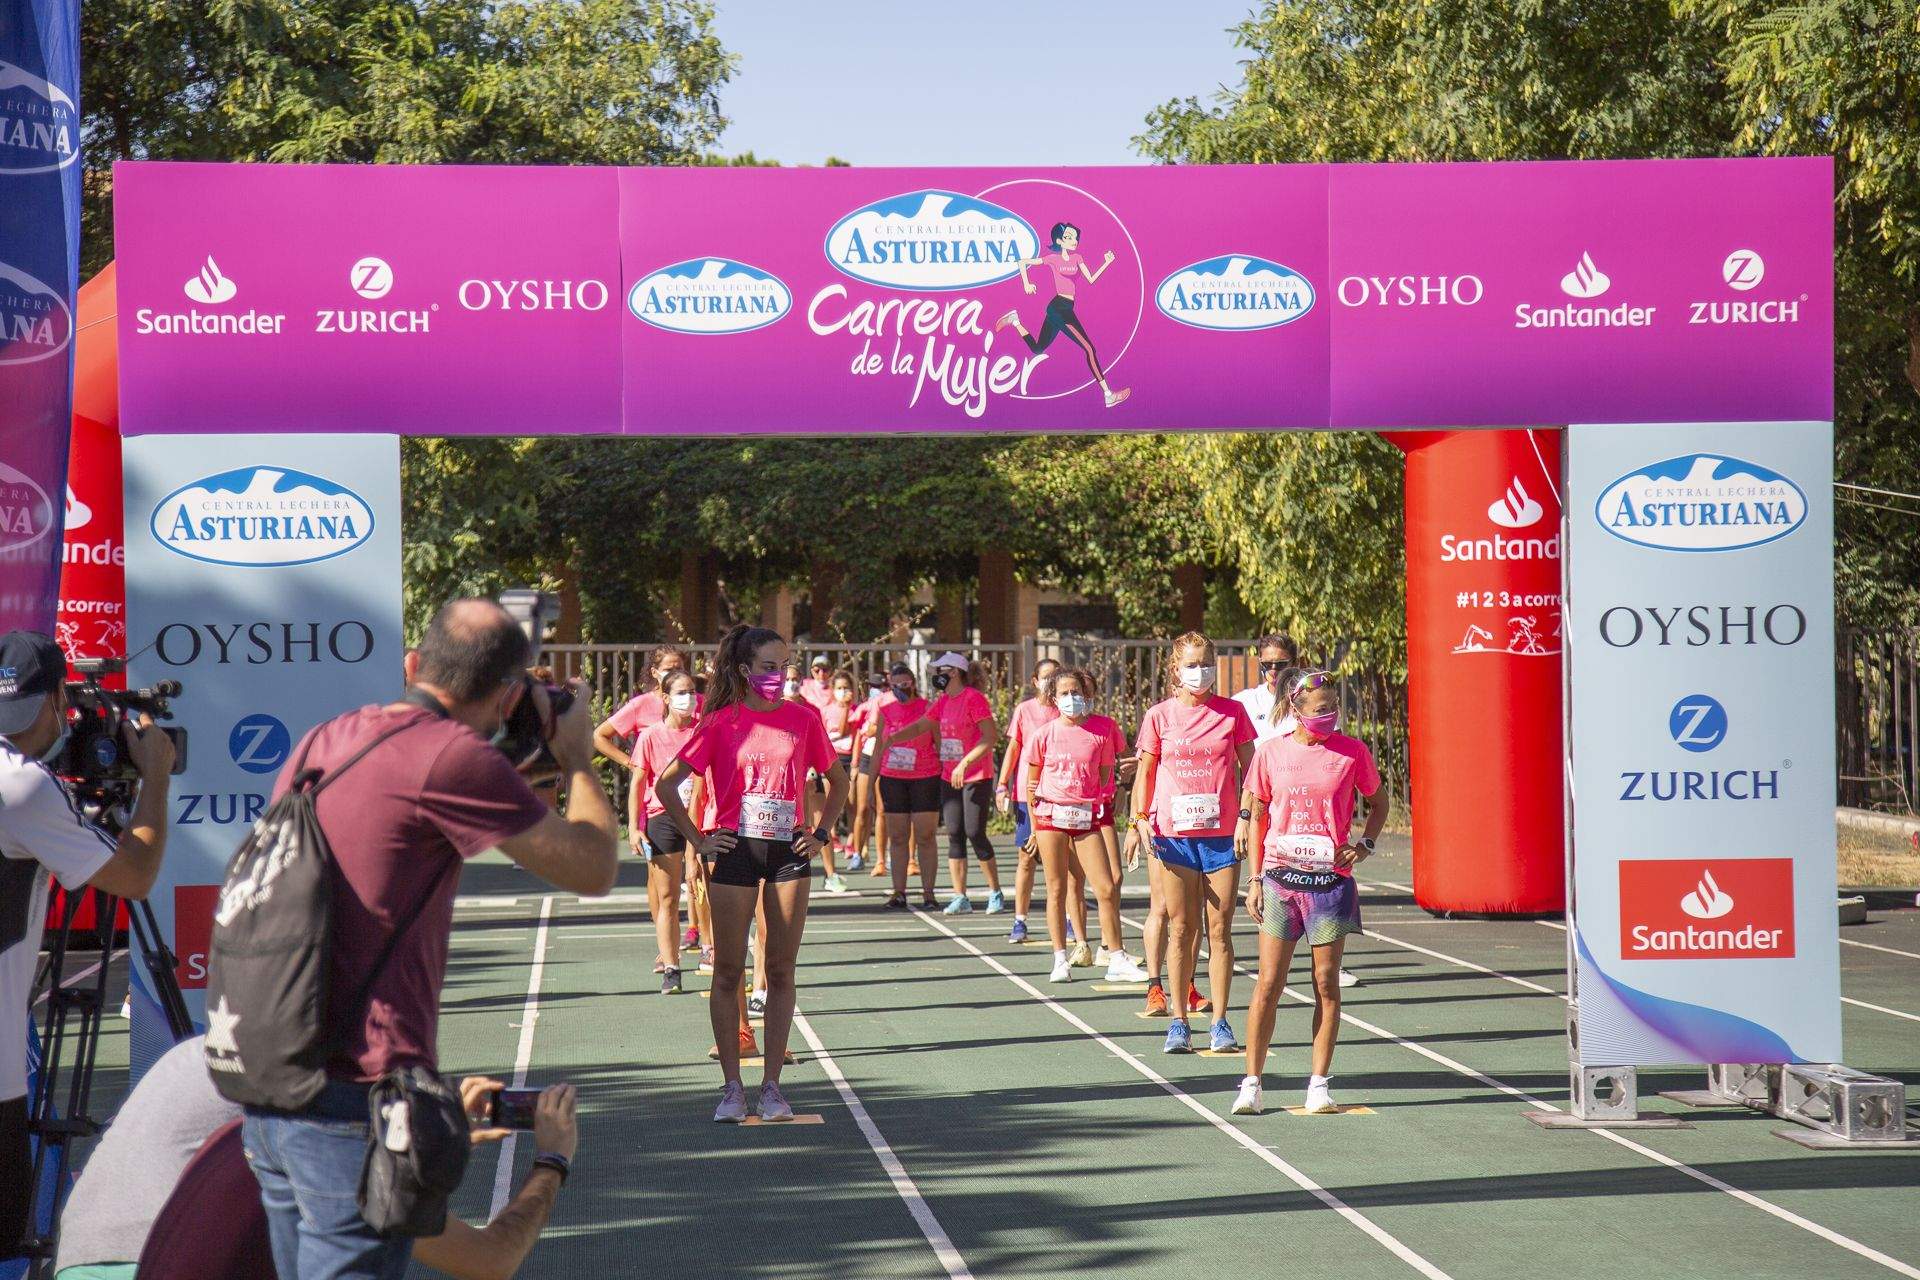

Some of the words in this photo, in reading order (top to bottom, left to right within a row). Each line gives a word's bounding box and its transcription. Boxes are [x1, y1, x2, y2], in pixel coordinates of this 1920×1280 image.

[874, 225, 942, 234] CENTRAL
[949, 224, 1016, 234] LECHERA
[842, 227, 1021, 264] ASTURIANA
[458, 279, 608, 311] OYSHO
[643, 286, 779, 313] ASTURIANA
[1169, 283, 1302, 310] ASTURIANA
[1337, 274, 1483, 308] OYSHO
[136, 309, 285, 334] Santander
[807, 283, 984, 337] Carrera
[1514, 302, 1656, 328] Santander
[851, 338, 884, 375] de
[891, 337, 914, 375] la
[909, 330, 1050, 418] Mujer
[202, 501, 272, 510] CENTRAL
[280, 500, 351, 510] LECHERA
[1644, 488, 1711, 497] CENTRAL
[1718, 487, 1786, 496] LECHERA
[1612, 490, 1793, 527] ASTURIANA
[168, 503, 358, 541] ASTURIANA
[1440, 533, 1560, 561] Santand
[1600, 604, 1807, 648] OYSHO
[155, 621, 374, 666] OYSHO
[1175, 738, 1191, 746] WE
[745, 752, 766, 762] WE
[1205, 759, 1212, 767] A
[1176, 769, 1213, 778] REASON
[1288, 786, 1308, 796] WE
[176, 793, 266, 825] ZUR
[758, 812, 778, 822] 016
[1186, 806, 1205, 814] 016
[1291, 811, 1310, 820] FOR
[1324, 811, 1331, 820] A
[1291, 823, 1331, 833] REASON
[1294, 847, 1316, 856] 016
[1632, 925, 1783, 951] Santander
